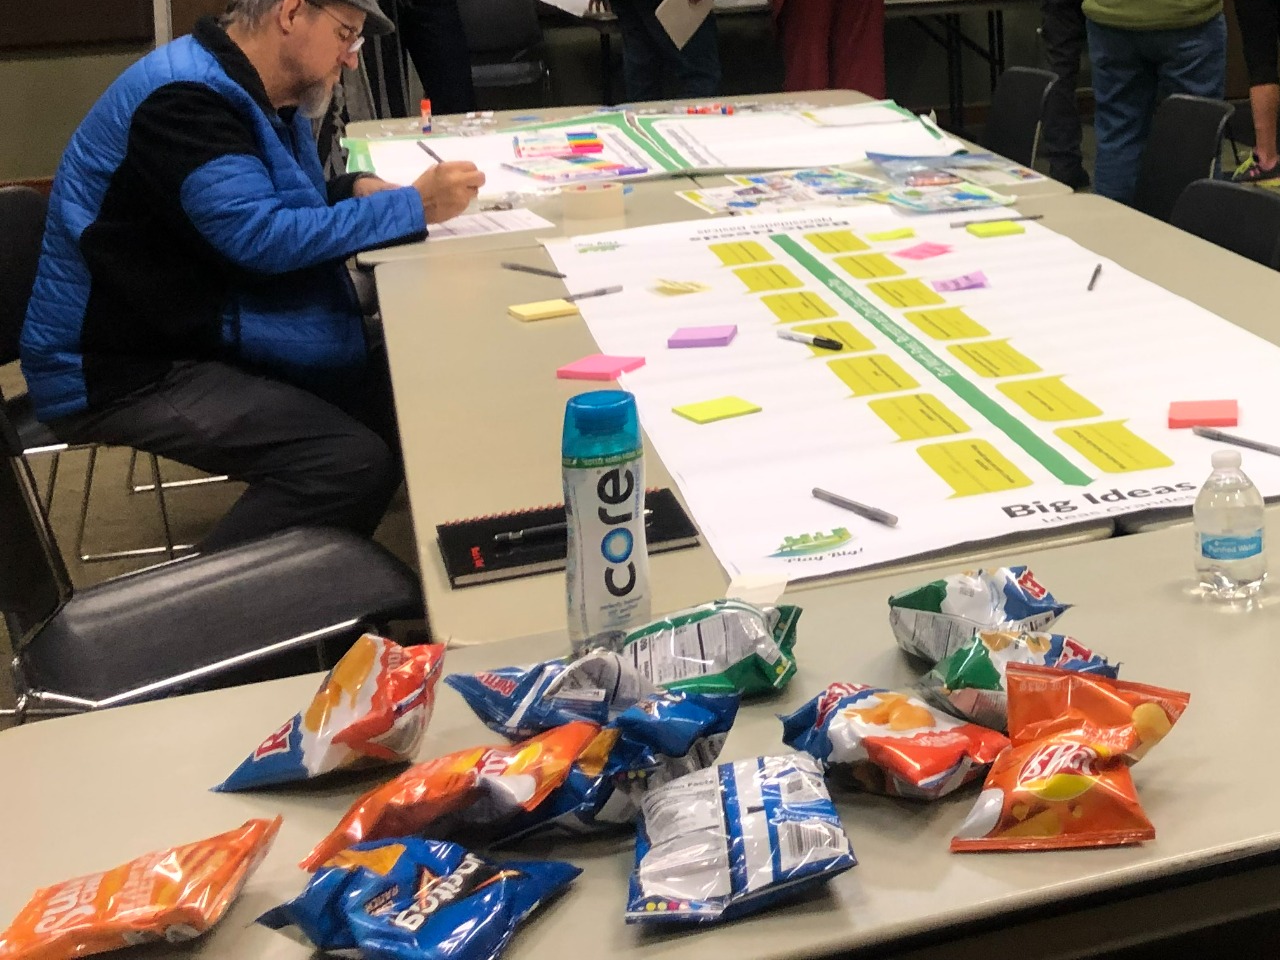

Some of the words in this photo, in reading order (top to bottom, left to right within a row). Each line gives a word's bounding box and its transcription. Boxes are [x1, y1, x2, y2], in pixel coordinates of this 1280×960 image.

[1001, 500, 1079, 519] Big
[1082, 481, 1197, 505] Ideas
[1041, 511, 1095, 524] Ideas
[1105, 494, 1197, 514] Grandes
[597, 467, 637, 598] core
